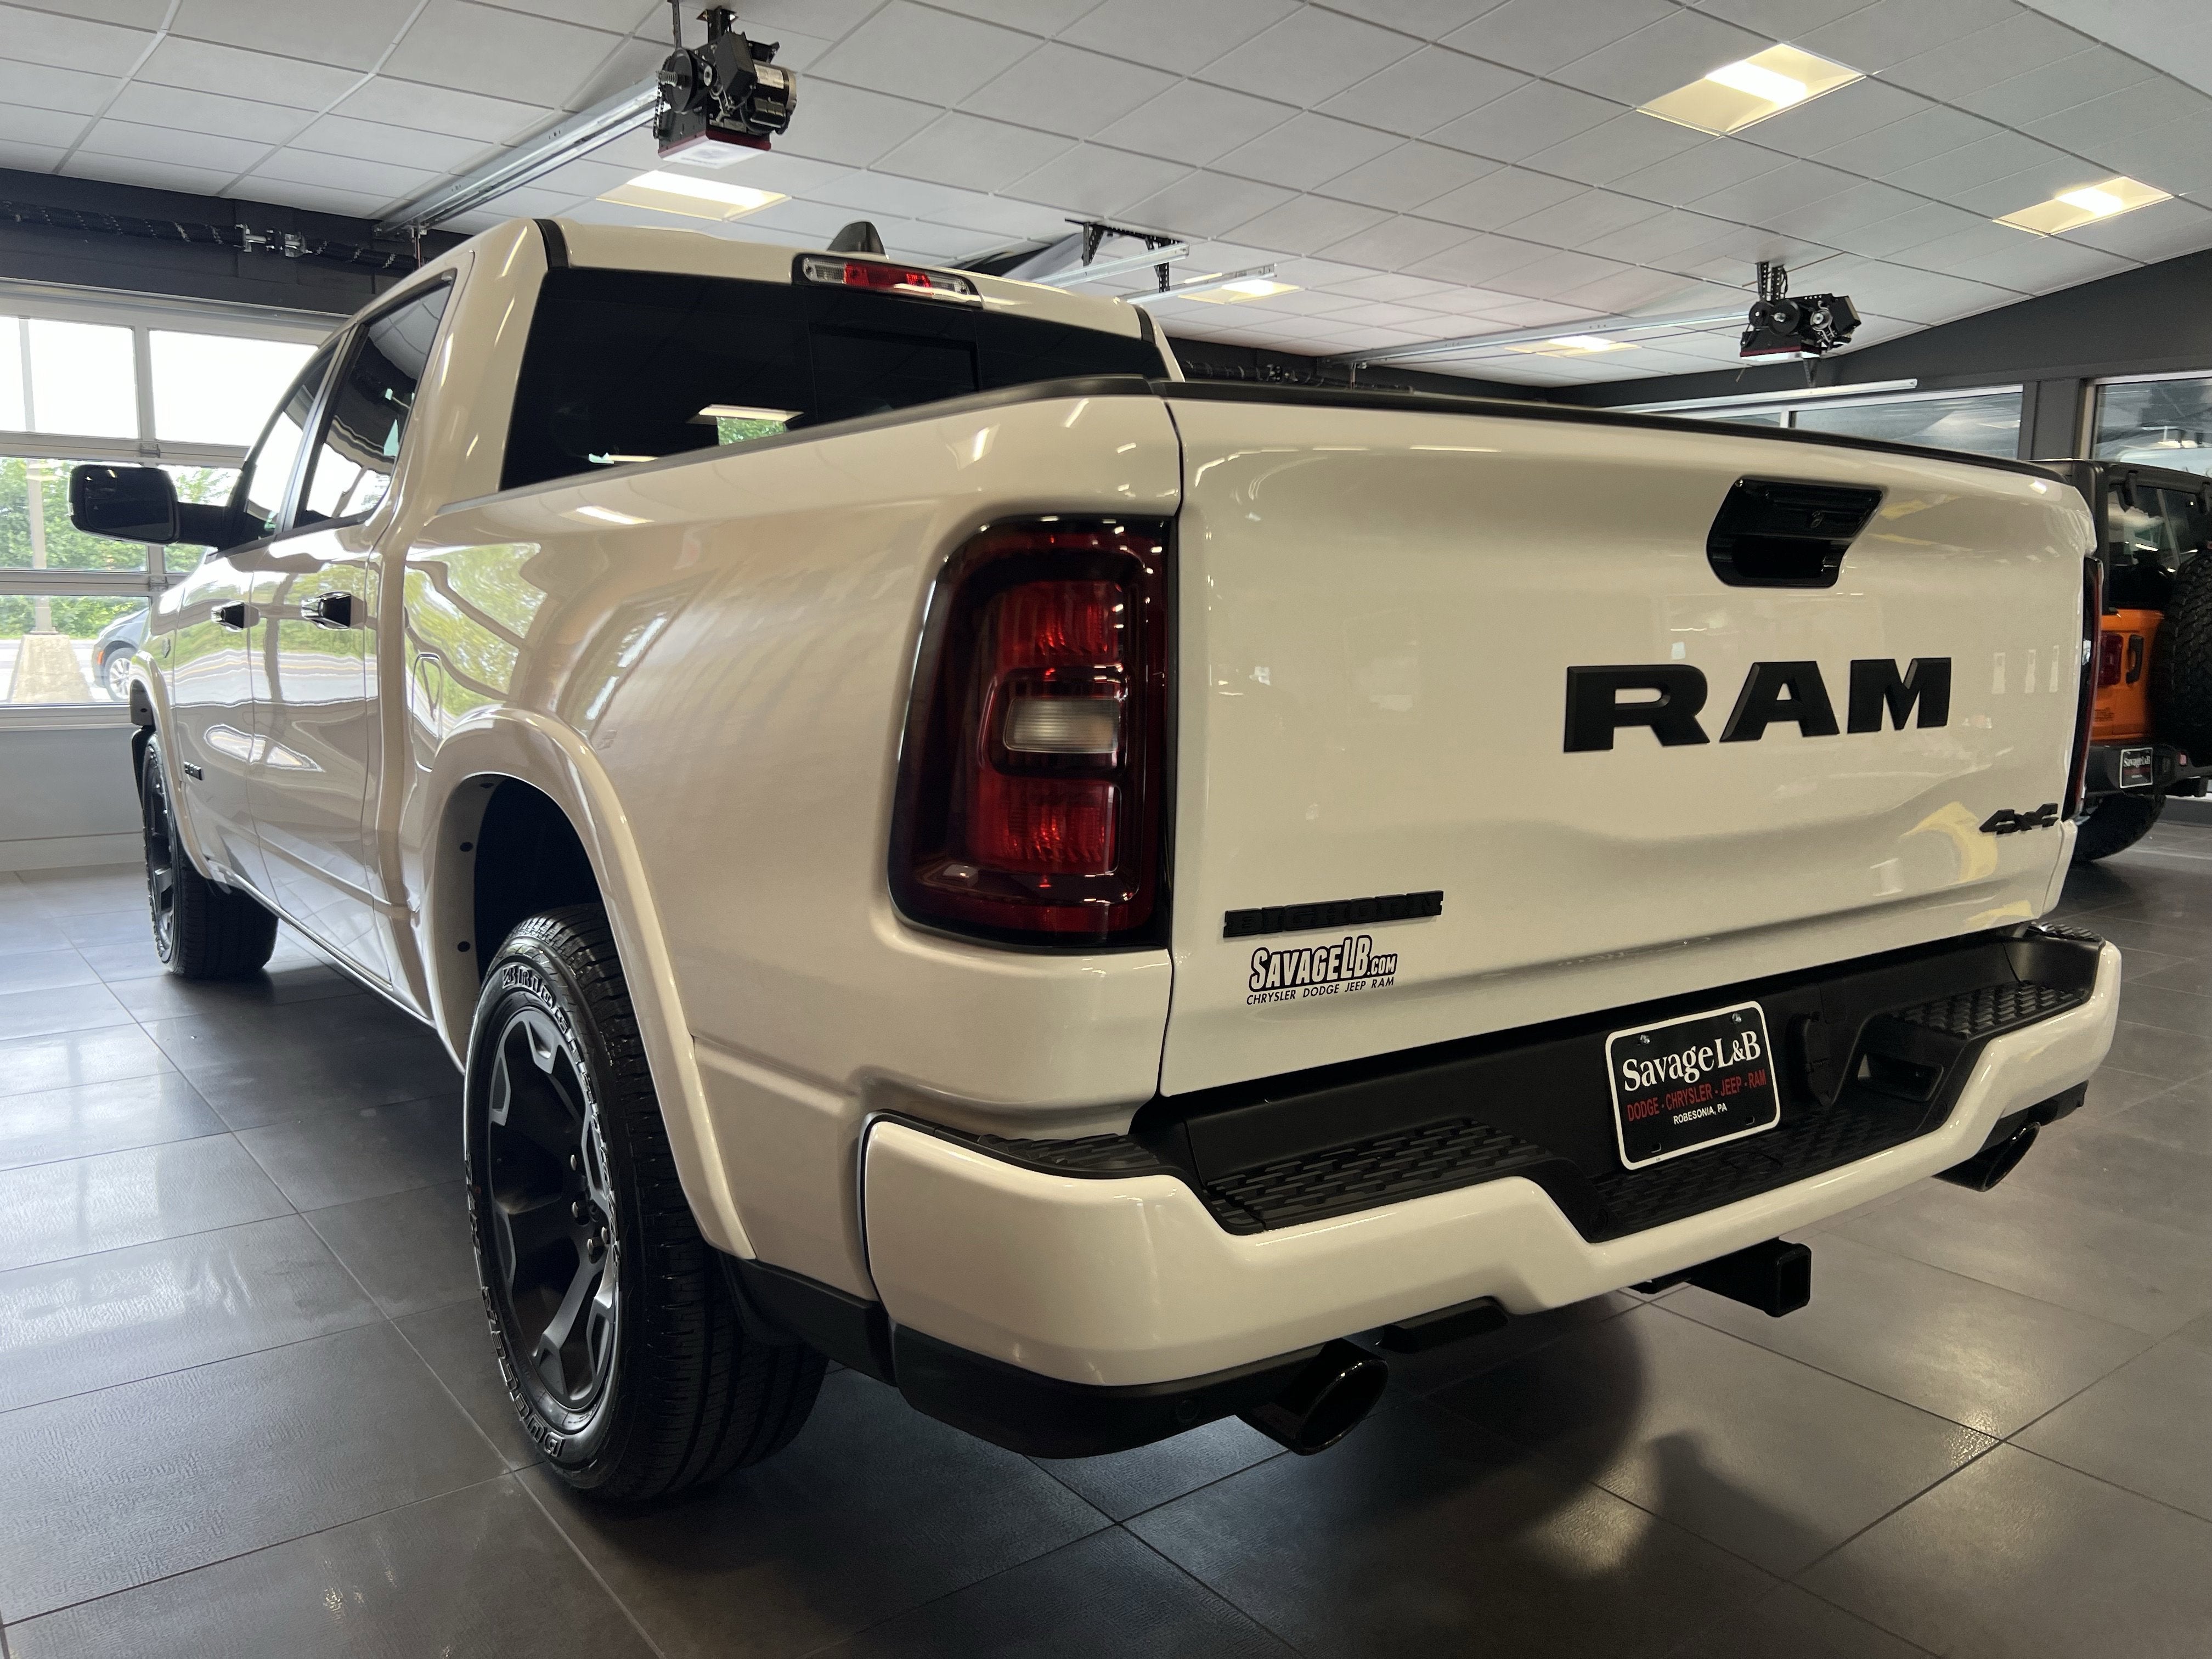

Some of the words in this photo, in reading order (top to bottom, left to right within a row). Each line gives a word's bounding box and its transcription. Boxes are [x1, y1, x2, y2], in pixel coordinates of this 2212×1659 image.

[1564, 657, 1951, 753] RAM
[1246, 990, 1296, 1005] CHRYSLER
[1302, 984, 1339, 998] DODGE
[1344, 980, 1366, 993] JEEP
[1371, 976, 1395, 989] RAM
[1627, 1097, 1660, 1122] DODGE
[1666, 1083, 1713, 1110] CHRYSLER
[1720, 1076, 1742, 1097] JEEP
[1748, 1069, 1767, 1088] RAM
[1673, 1105, 1717, 1125] ROBESONIA,
[1717, 1103, 1728, 1113] PA
